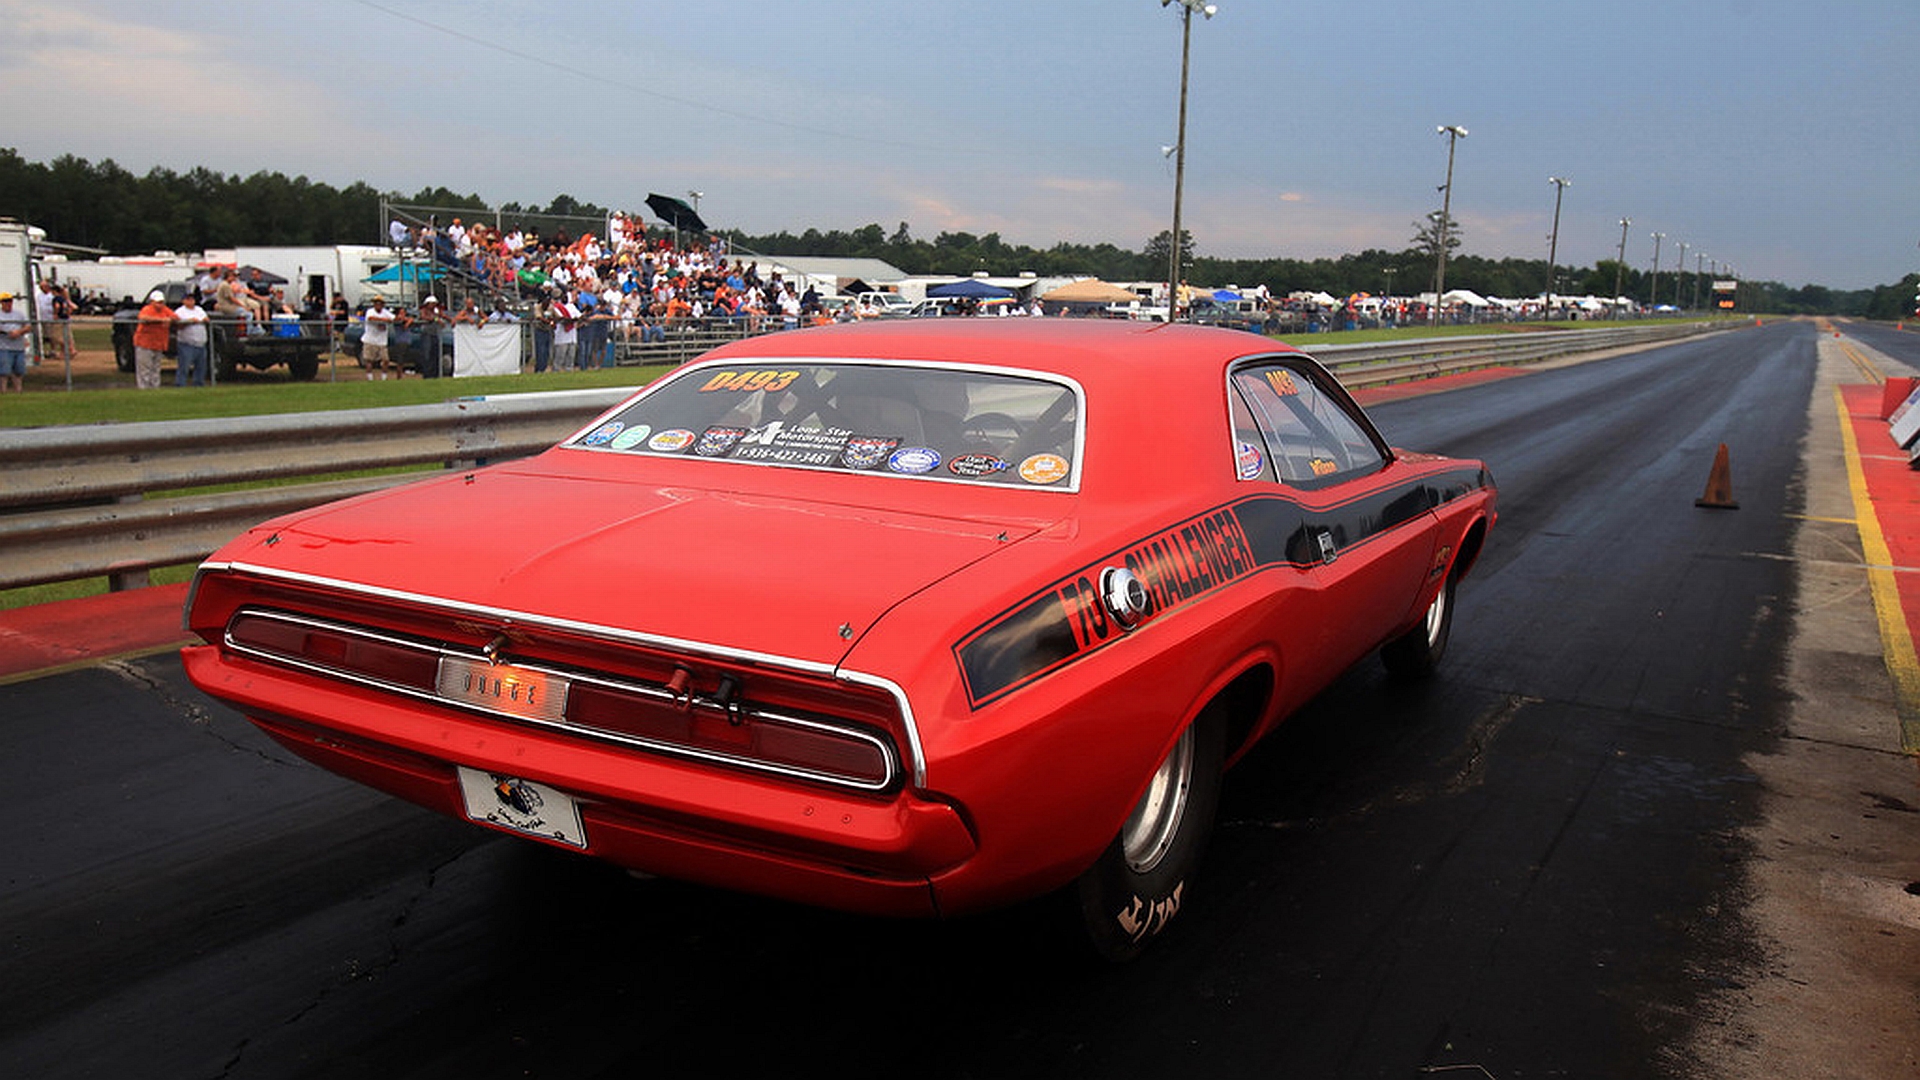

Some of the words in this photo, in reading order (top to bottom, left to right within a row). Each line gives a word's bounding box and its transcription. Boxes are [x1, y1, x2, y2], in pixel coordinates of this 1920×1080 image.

[700, 371, 800, 393] D493
[776, 431, 849, 445] Motorsport
[790, 424, 820, 435] Lone
[824, 425, 853, 437] Star
[464, 671, 536, 705] DODGE
